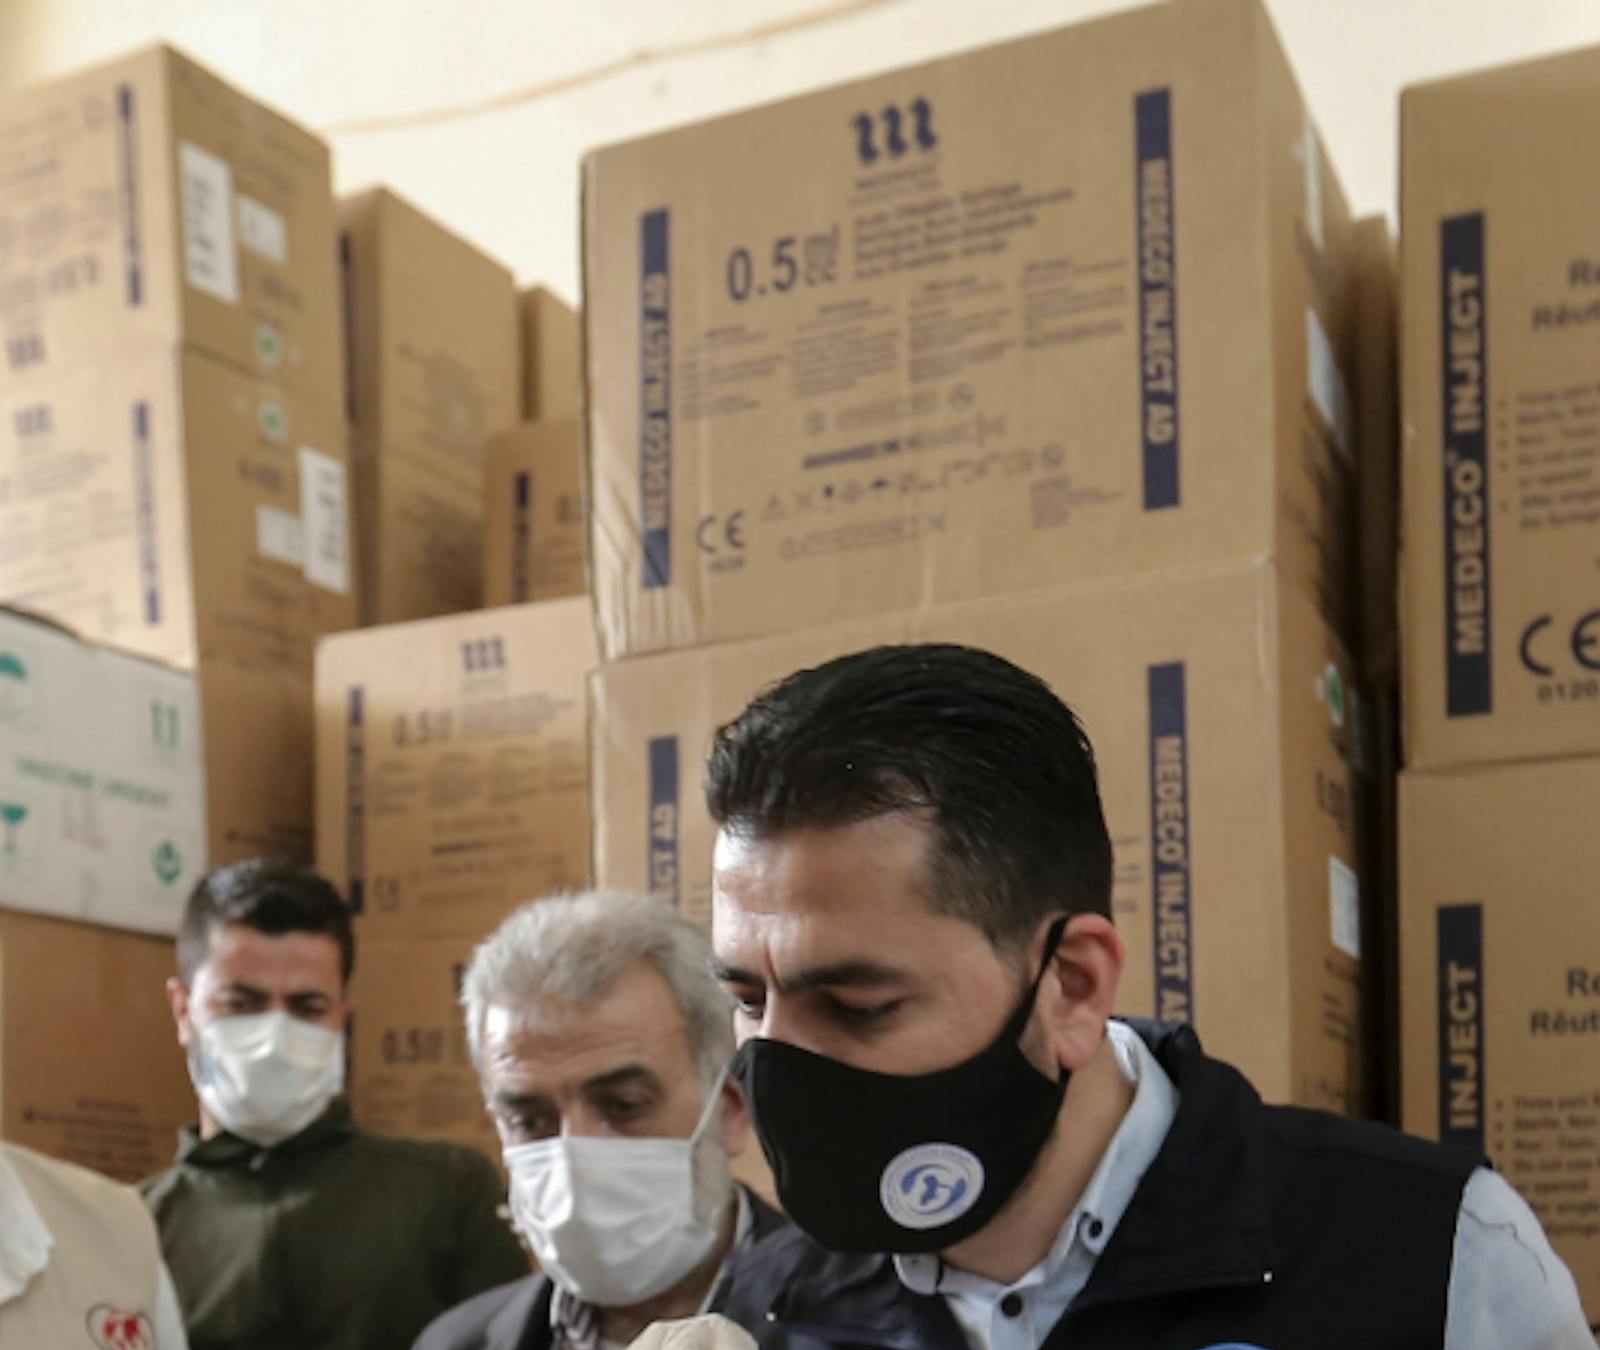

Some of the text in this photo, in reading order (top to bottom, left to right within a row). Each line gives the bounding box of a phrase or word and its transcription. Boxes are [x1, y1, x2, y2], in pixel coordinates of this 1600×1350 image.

[726, 237, 798, 302] 0.5
[1449, 268, 1486, 655] MEDECO INJECT
[1154, 734, 1185, 860] MEDECO
[652, 849, 678, 904] ECT
[1157, 872, 1188, 982] INJECT
[1448, 960, 1478, 1130] INJECT
